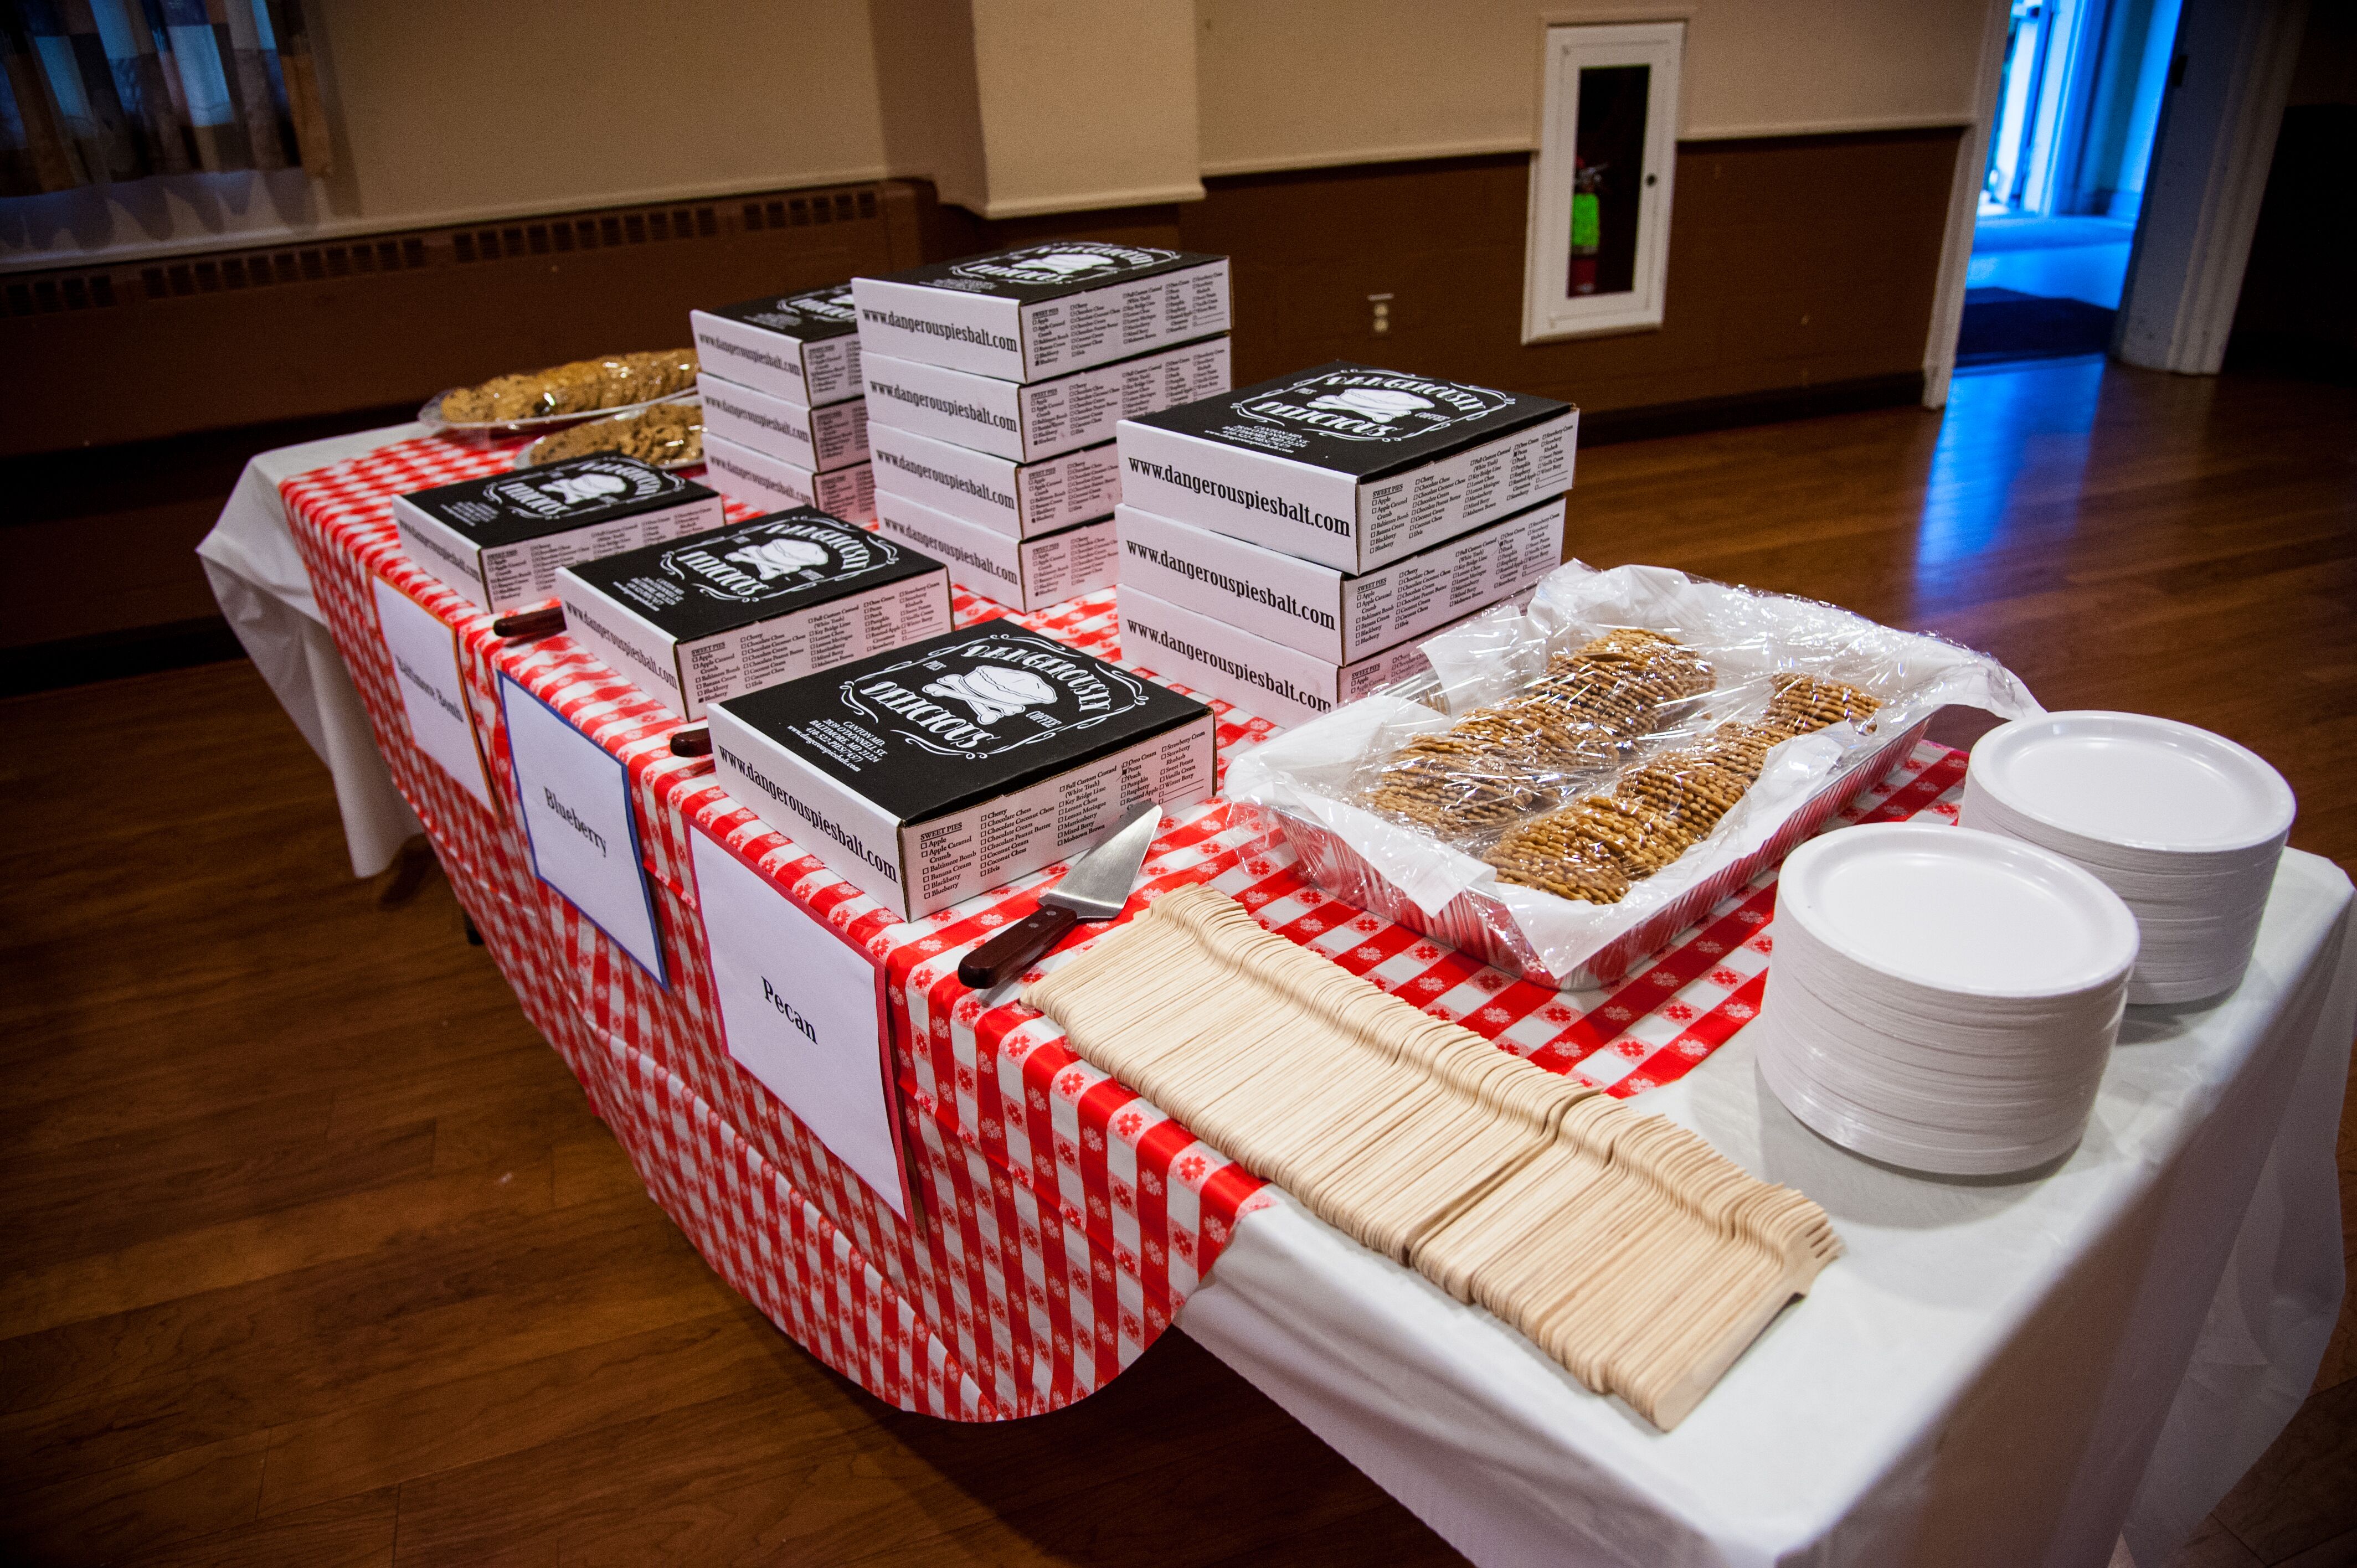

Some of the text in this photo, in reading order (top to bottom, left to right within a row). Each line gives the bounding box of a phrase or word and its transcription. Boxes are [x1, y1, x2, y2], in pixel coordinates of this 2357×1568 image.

[862, 308, 1017, 352] www.dangerouspiesbalt.com
[1325, 376, 1486, 411] DANGEROUSLY
[869, 380, 1017, 432] www.dangerouspiesbalt.com
[1251, 402, 1403, 436] DELICIOUS
[876, 449, 1015, 509] www.dangerouspiesbalt.com
[1128, 457, 1351, 537] www.dangerouspiesbalt.com
[883, 517, 1018, 585] www.dangerouspiesbalt.com
[1126, 540, 1335, 630] www.dangerouspiesbalt.com
[565, 600, 677, 689] www.dangerouspiesbalt.com
[923, 660, 946, 672] PIES
[1127, 620, 1331, 713] www.dangerouspiesbalt.com
[961, 645, 1111, 712] DANGEROUSLY
[860, 682, 1000, 747] DELICIOUS
[1025, 710, 1063, 729] COFFEE
[822, 719, 840, 729] 2839
[874, 749, 888, 757] ST.
[843, 721, 874, 742] CANTON
[1167, 731, 1205, 750] Strawberry Cream
[788, 725, 861, 772] www.dangerouspiesbalt.com
[847, 742, 862, 751] MD
[859, 750, 882, 762] 21224
[1167, 745, 1190, 757] Strawberry
[1167, 754, 1185, 765] Rhubarb
[1066, 766, 1116, 790] Full Custom Custard
[1128, 771, 1141, 781] Peach
[1128, 777, 1148, 788] Pumpkin
[1165, 778, 1180, 787] Winter
[1166, 771, 1180, 780] Vanilla
[1066, 780, 1099, 798] (White Trash)
[1076, 792, 1092, 801] Bridge
[1126, 792, 1144, 803] Roasted
[1146, 787, 1158, 796] Apple
[1127, 784, 1150, 796] Raspberry
[718, 745, 898, 883] www.dangerouspiesbalt.com
[988, 809, 1007, 818] Cherry
[1064, 802, 1106, 821] Lemon Meringue
[1065, 804, 1082, 813] Lemon
[544, 786, 606, 858] Blueberry
[987, 822, 1014, 834] Chocolate
[1016, 813, 1038, 824] Coconut
[988, 814, 1015, 827] Chocolate
[1064, 813, 1097, 829] Marrionberry
[1064, 822, 1094, 837] Mixed Berry
[920, 823, 962, 840] SWEET PIES
[987, 823, 1032, 843] Chocolate Cream
[987, 823, 1051, 850] Chocolate Peanut Butter
[1064, 825, 1105, 844] Mobtown Brown
[929, 837, 946, 848] Apple
[929, 835, 971, 856] Apple Caramel
[987, 840, 1028, 858] Coconut Cream
[930, 852, 951, 863] Crumb
[930, 850, 976, 872] Baltimore Bomb
[987, 848, 1026, 866] Coconut Chess
[931, 862, 971, 880] Banana Cream
[987, 865, 1000, 874] Elvis
[932, 874, 961, 889] Blackberry
[932, 883, 959, 896] Blueberry
[761, 976, 817, 1045] Pecan
